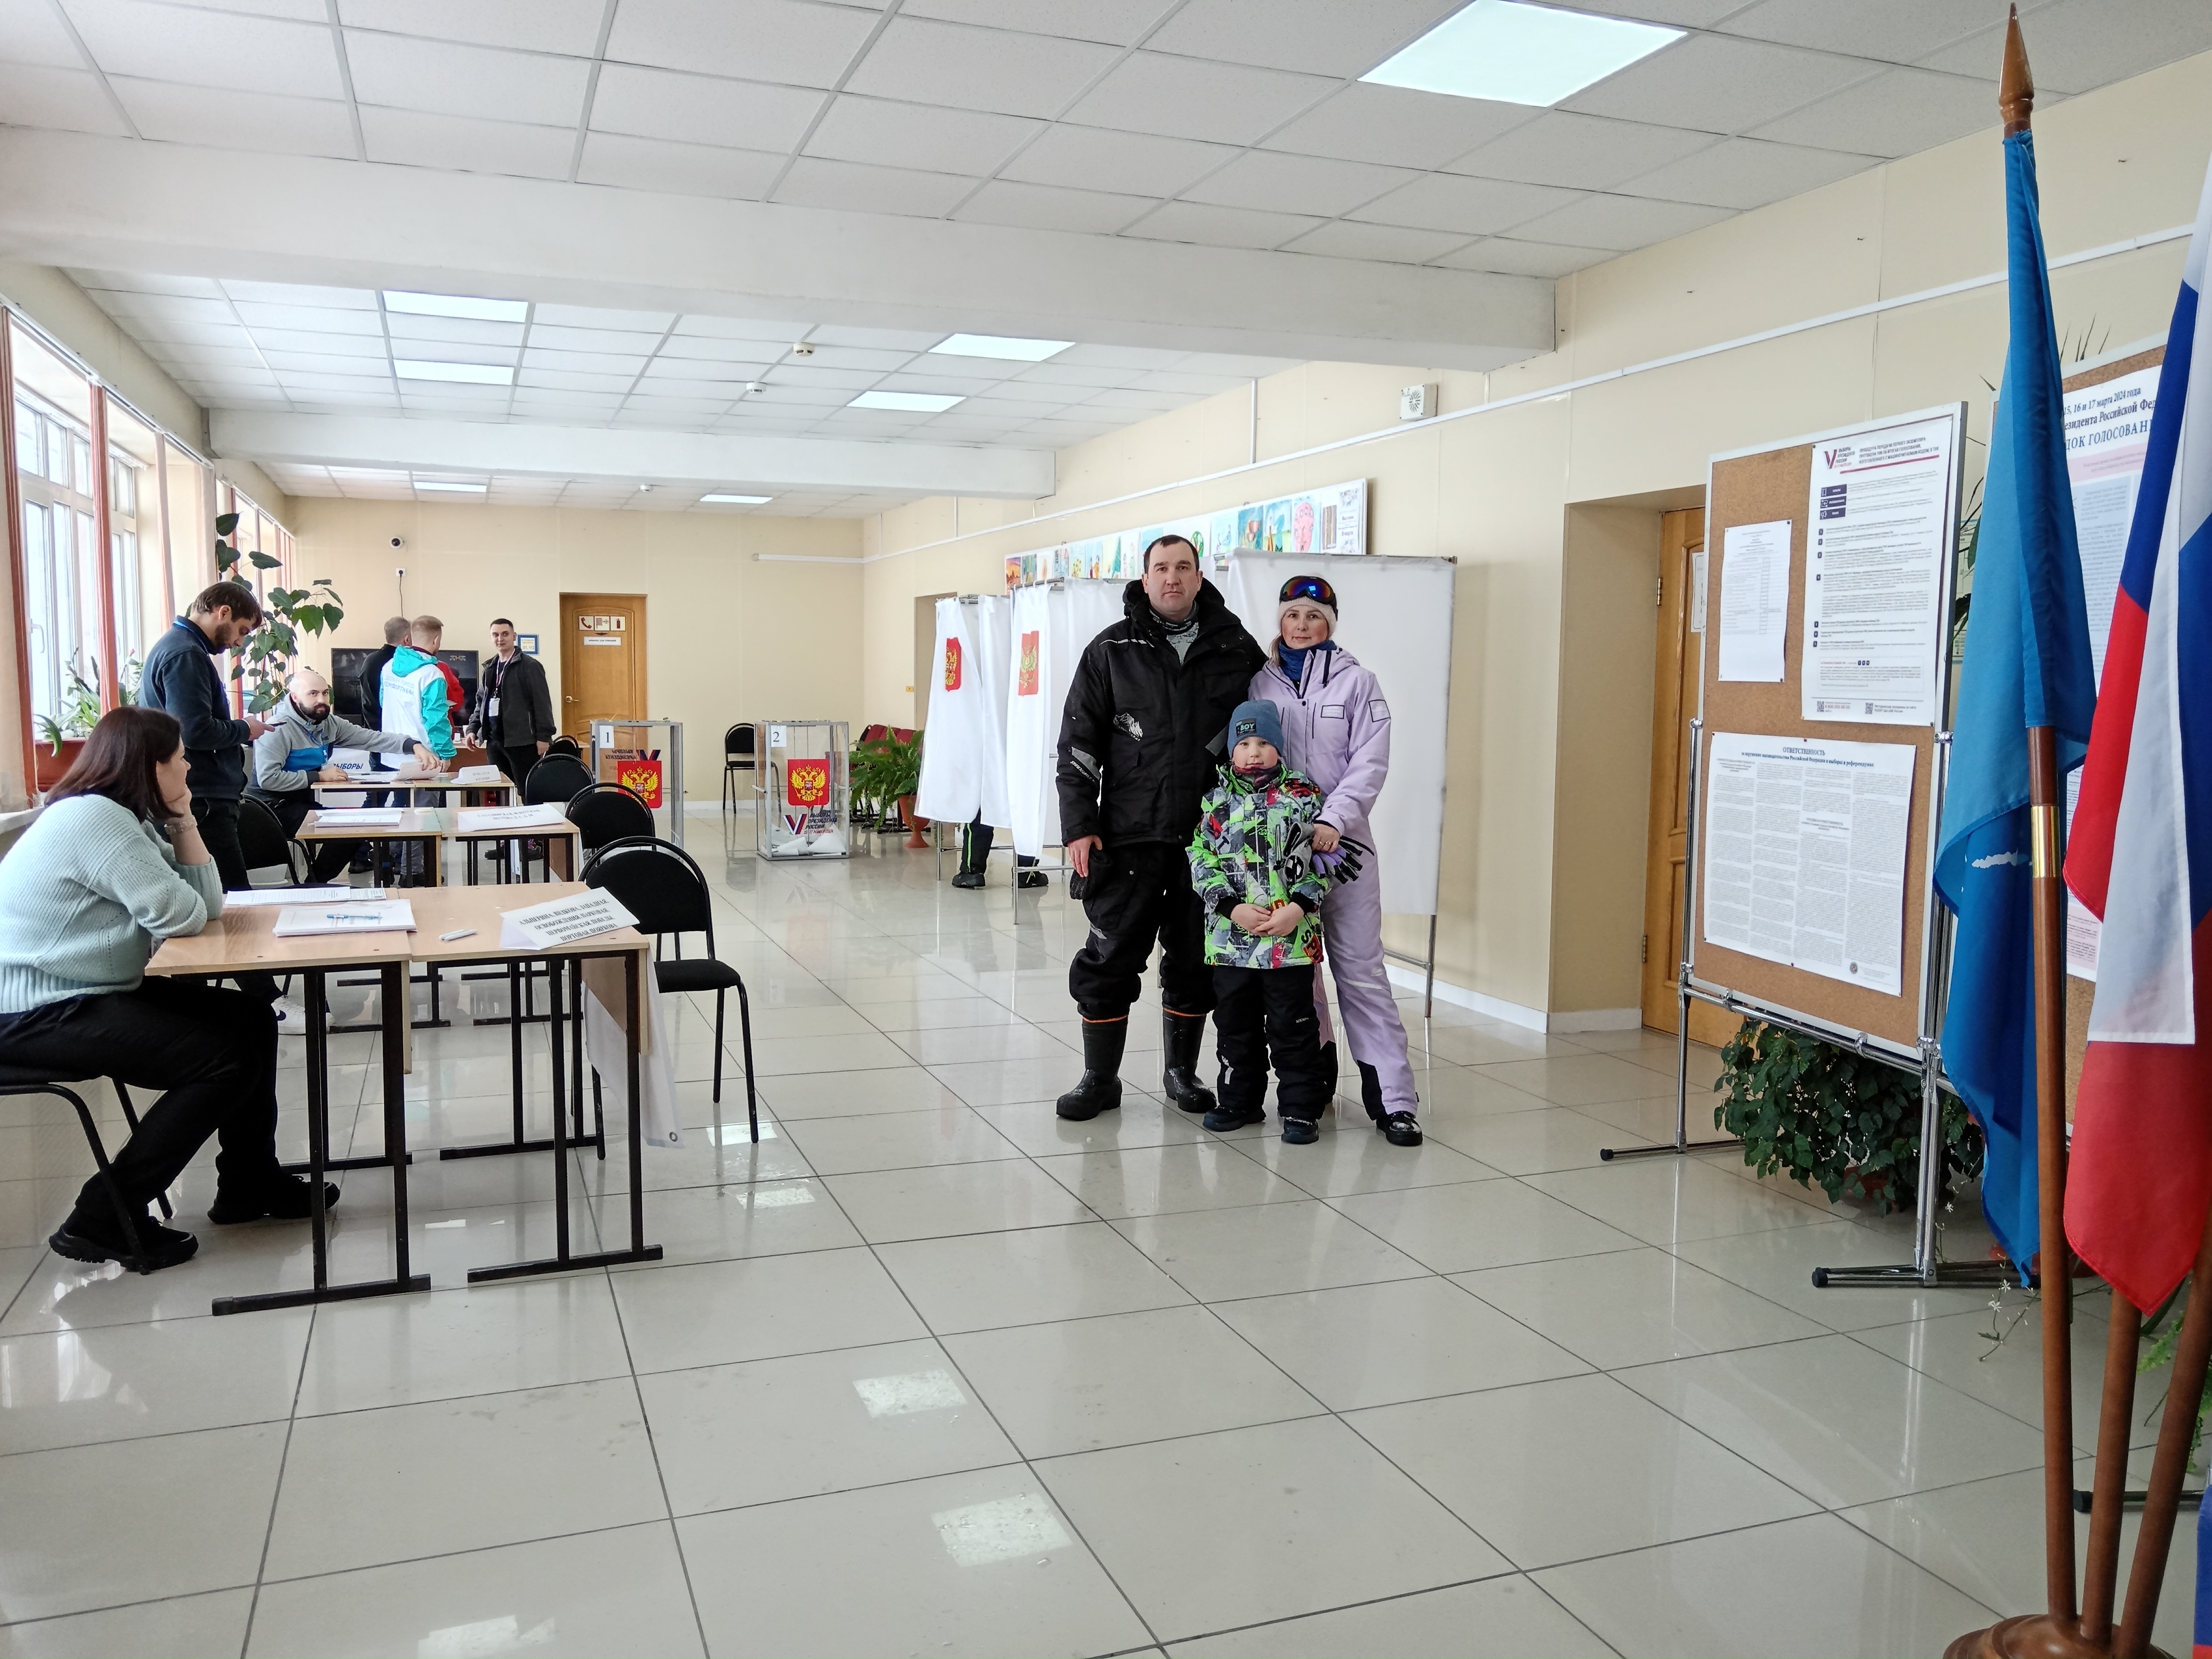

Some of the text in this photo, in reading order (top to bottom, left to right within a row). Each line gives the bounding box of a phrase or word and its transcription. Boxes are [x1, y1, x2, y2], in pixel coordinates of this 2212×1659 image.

[2074, 403, 2081, 412] 16
[2089, 399, 2096, 409] 17
[2097, 397, 2112, 408] марта
[2114, 390, 2126, 401] 2024
[2127, 388, 2141, 398] года
[2065, 399, 2157, 430] езидента Российской Фед
[2066, 419, 2152, 451] ДОК ГОЛОСОВАН
[606, 732, 610, 742] 1
[773, 732, 779, 742] 2
[1783, 747, 1825, 756] ОТВЕТСТВЕННОСТЬ
[580, 908, 610, 918] ПАРКОВАЯ,
[589, 923, 618, 933] ПОЯРКОВА
